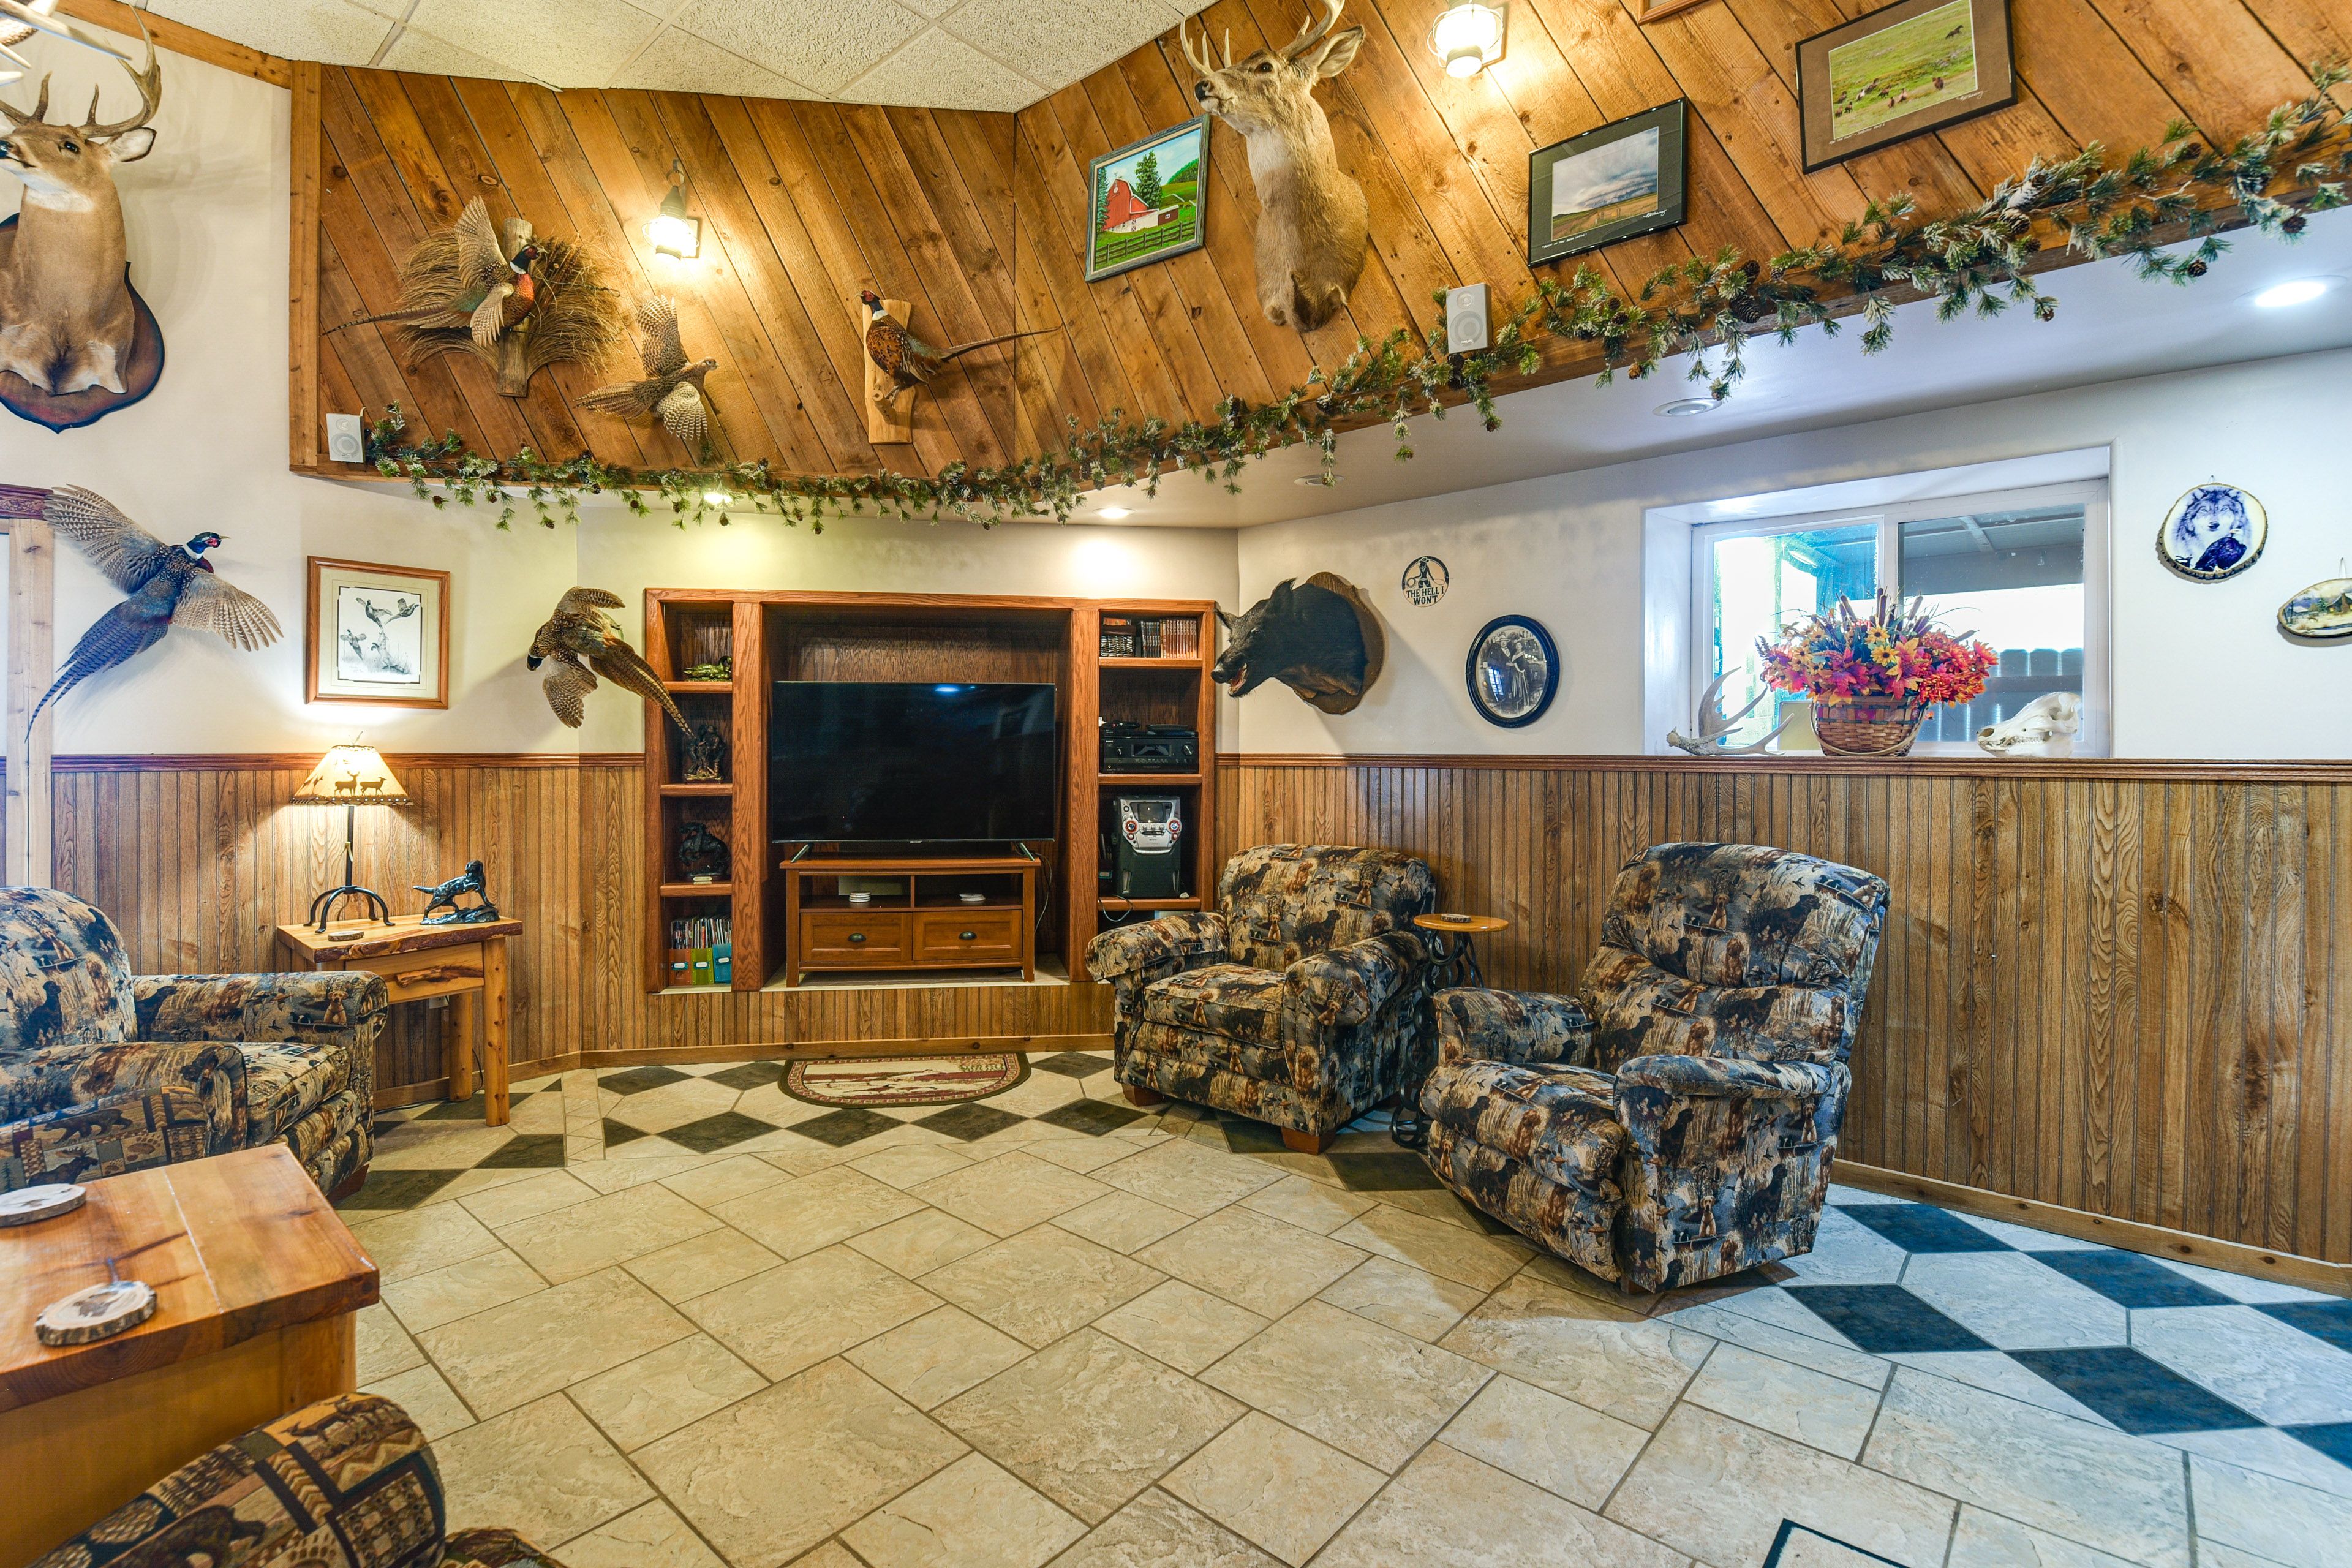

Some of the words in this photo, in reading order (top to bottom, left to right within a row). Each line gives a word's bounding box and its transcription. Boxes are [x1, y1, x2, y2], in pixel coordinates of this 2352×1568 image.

[1406, 589, 1420, 598] THE
[1422, 587, 1439, 596] HELL
[1413, 595, 1438, 605] WON'T
